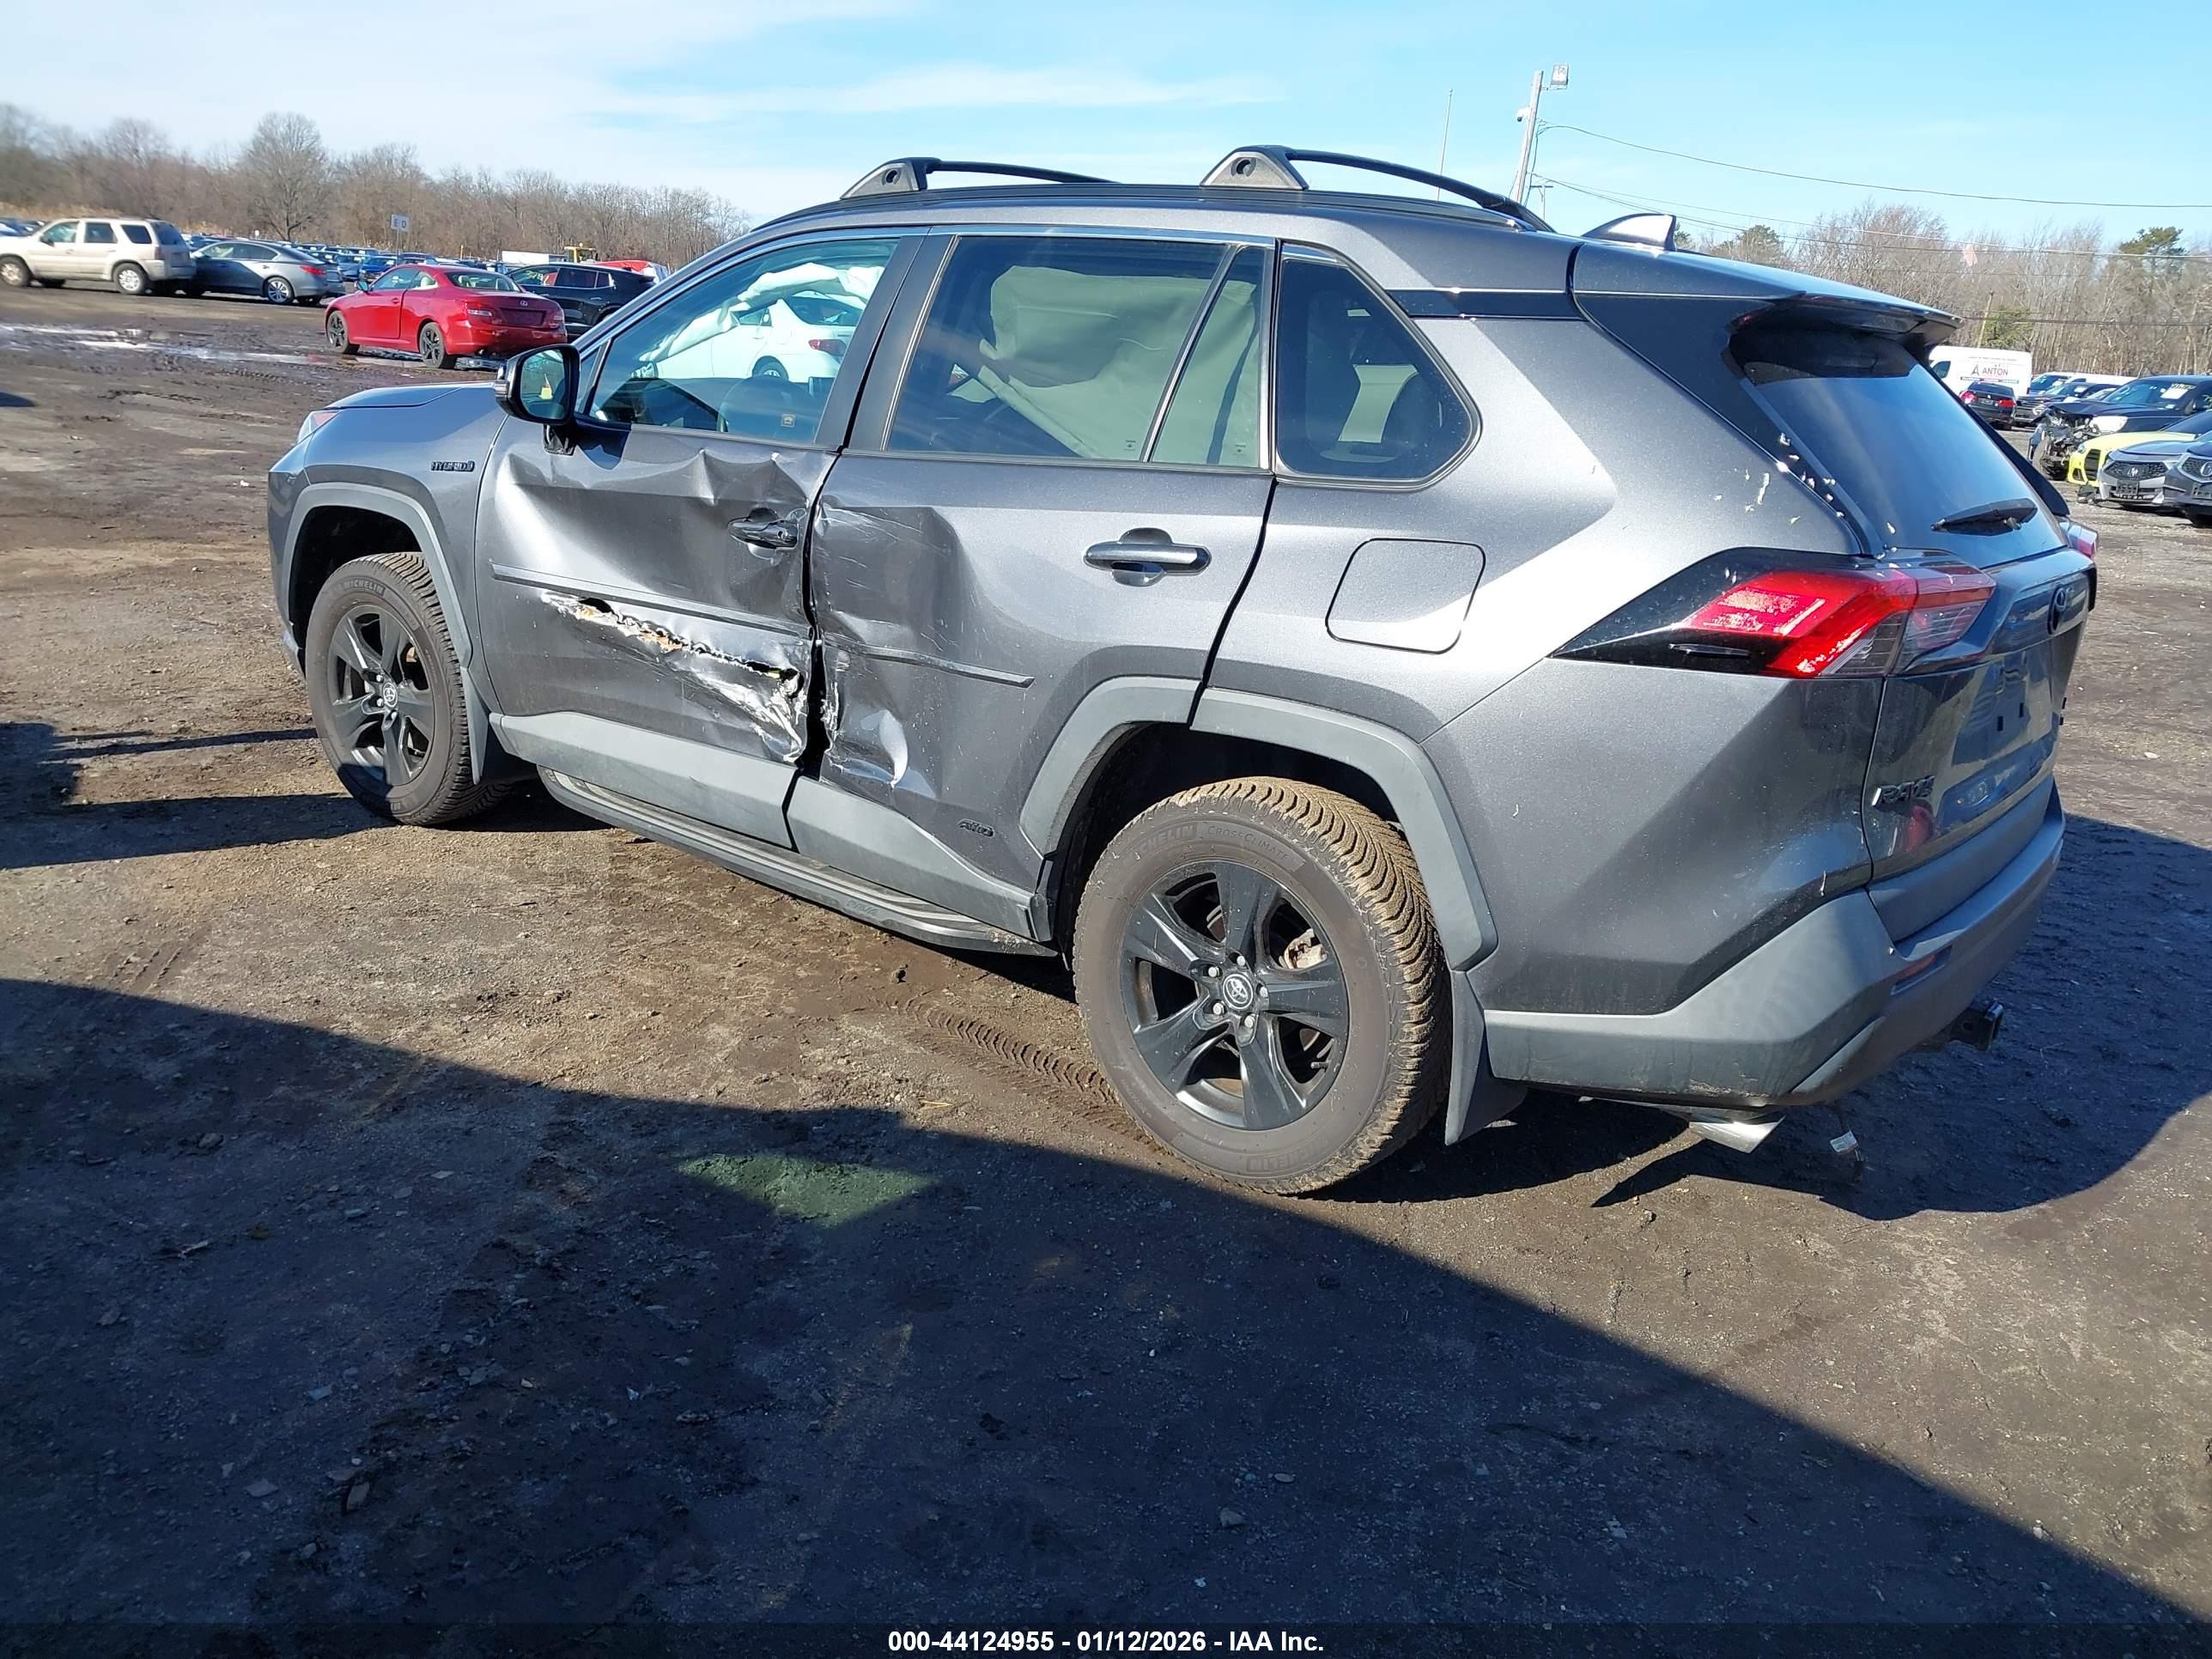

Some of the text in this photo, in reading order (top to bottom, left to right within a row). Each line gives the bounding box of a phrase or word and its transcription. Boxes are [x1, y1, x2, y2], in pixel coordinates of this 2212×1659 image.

[1982, 367, 2008, 376] ANTON
[430, 460, 476, 472] HYBRID
[1872, 775, 1935, 806] RAV4
